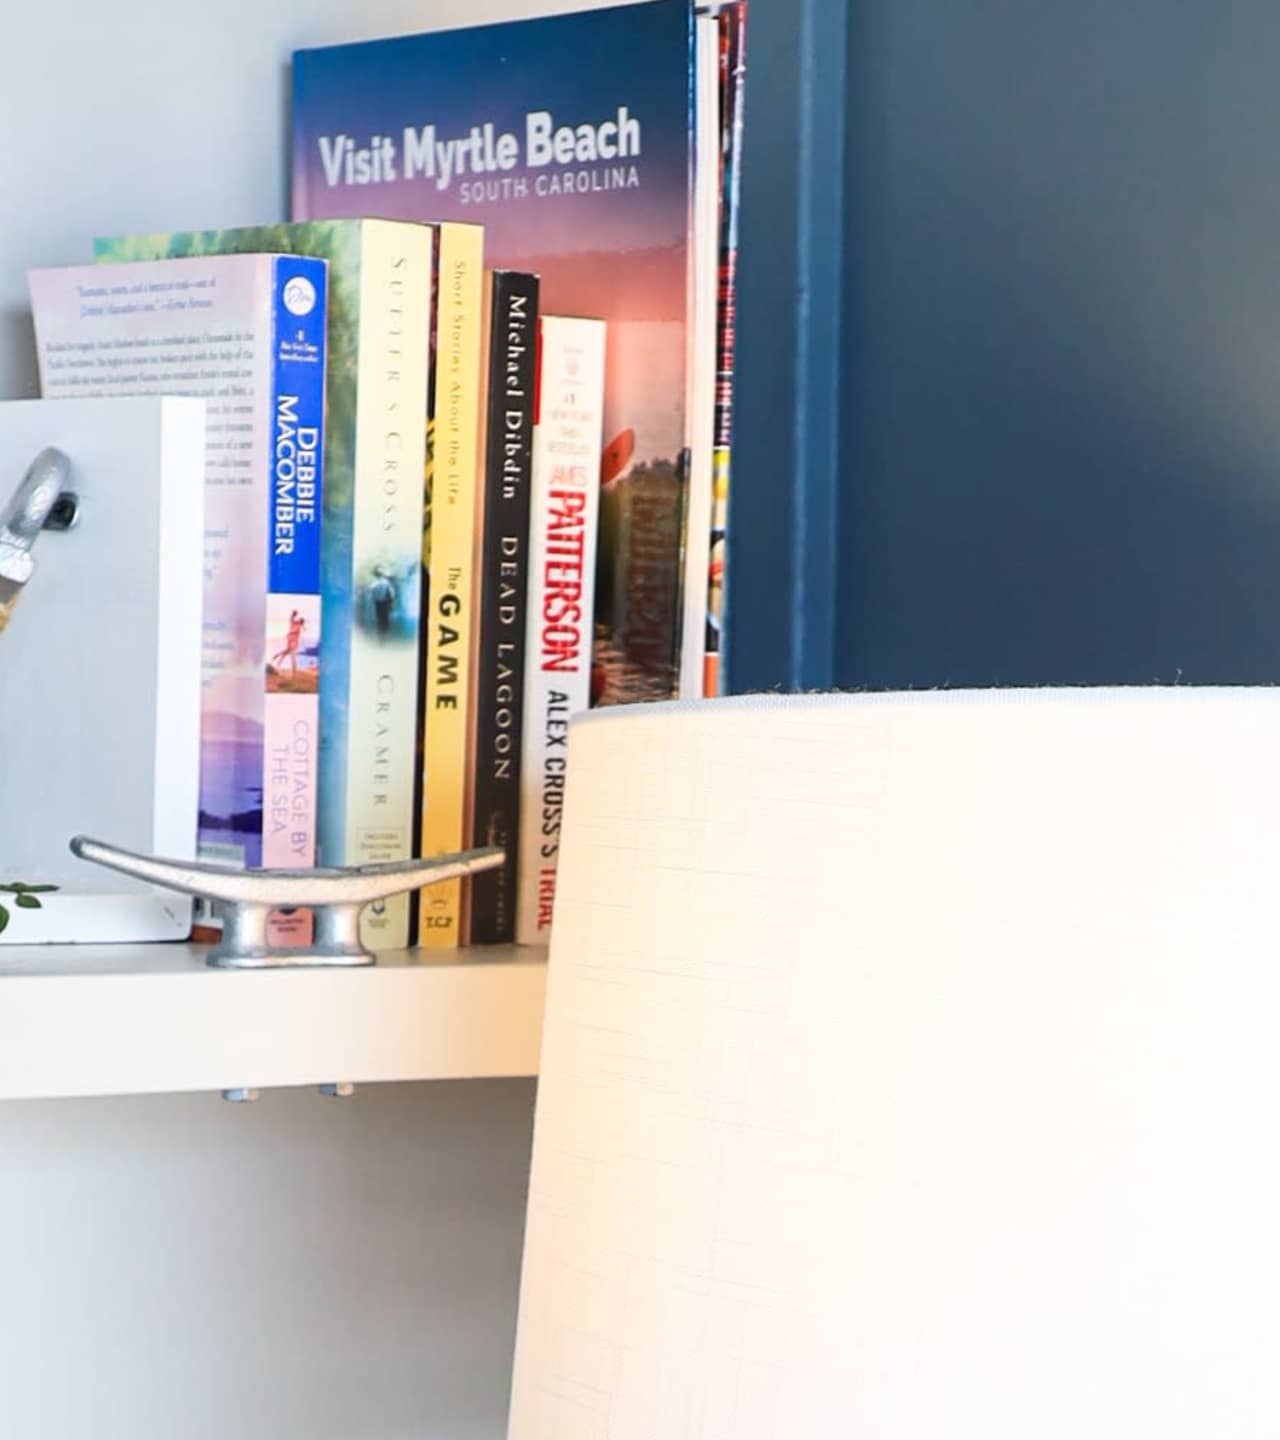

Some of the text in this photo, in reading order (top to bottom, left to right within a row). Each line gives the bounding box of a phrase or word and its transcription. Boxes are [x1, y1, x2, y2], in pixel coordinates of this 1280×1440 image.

[319, 106, 641, 191] Visit Myrtle Beach
[459, 165, 641, 205] SOUTH CAROLINA
[447, 260, 467, 505] Short Stories About the Life
[502, 295, 528, 500] Michael Dibdin
[274, 394, 299, 556] MACOMBER
[295, 426, 318, 523] DEBBIE
[449, 567, 462, 590] The
[540, 490, 586, 674] PATTERSON
[436, 593, 461, 710] GAME
[494, 536, 519, 780] DEAD LAGOON
[373, 673, 395, 805] CRAMER
[547, 689, 570, 748] ALEX
[270, 745, 290, 834] THE SEA
[290, 719, 310, 857] COTTAGE BY
[541, 758, 565, 858] CROSSS
